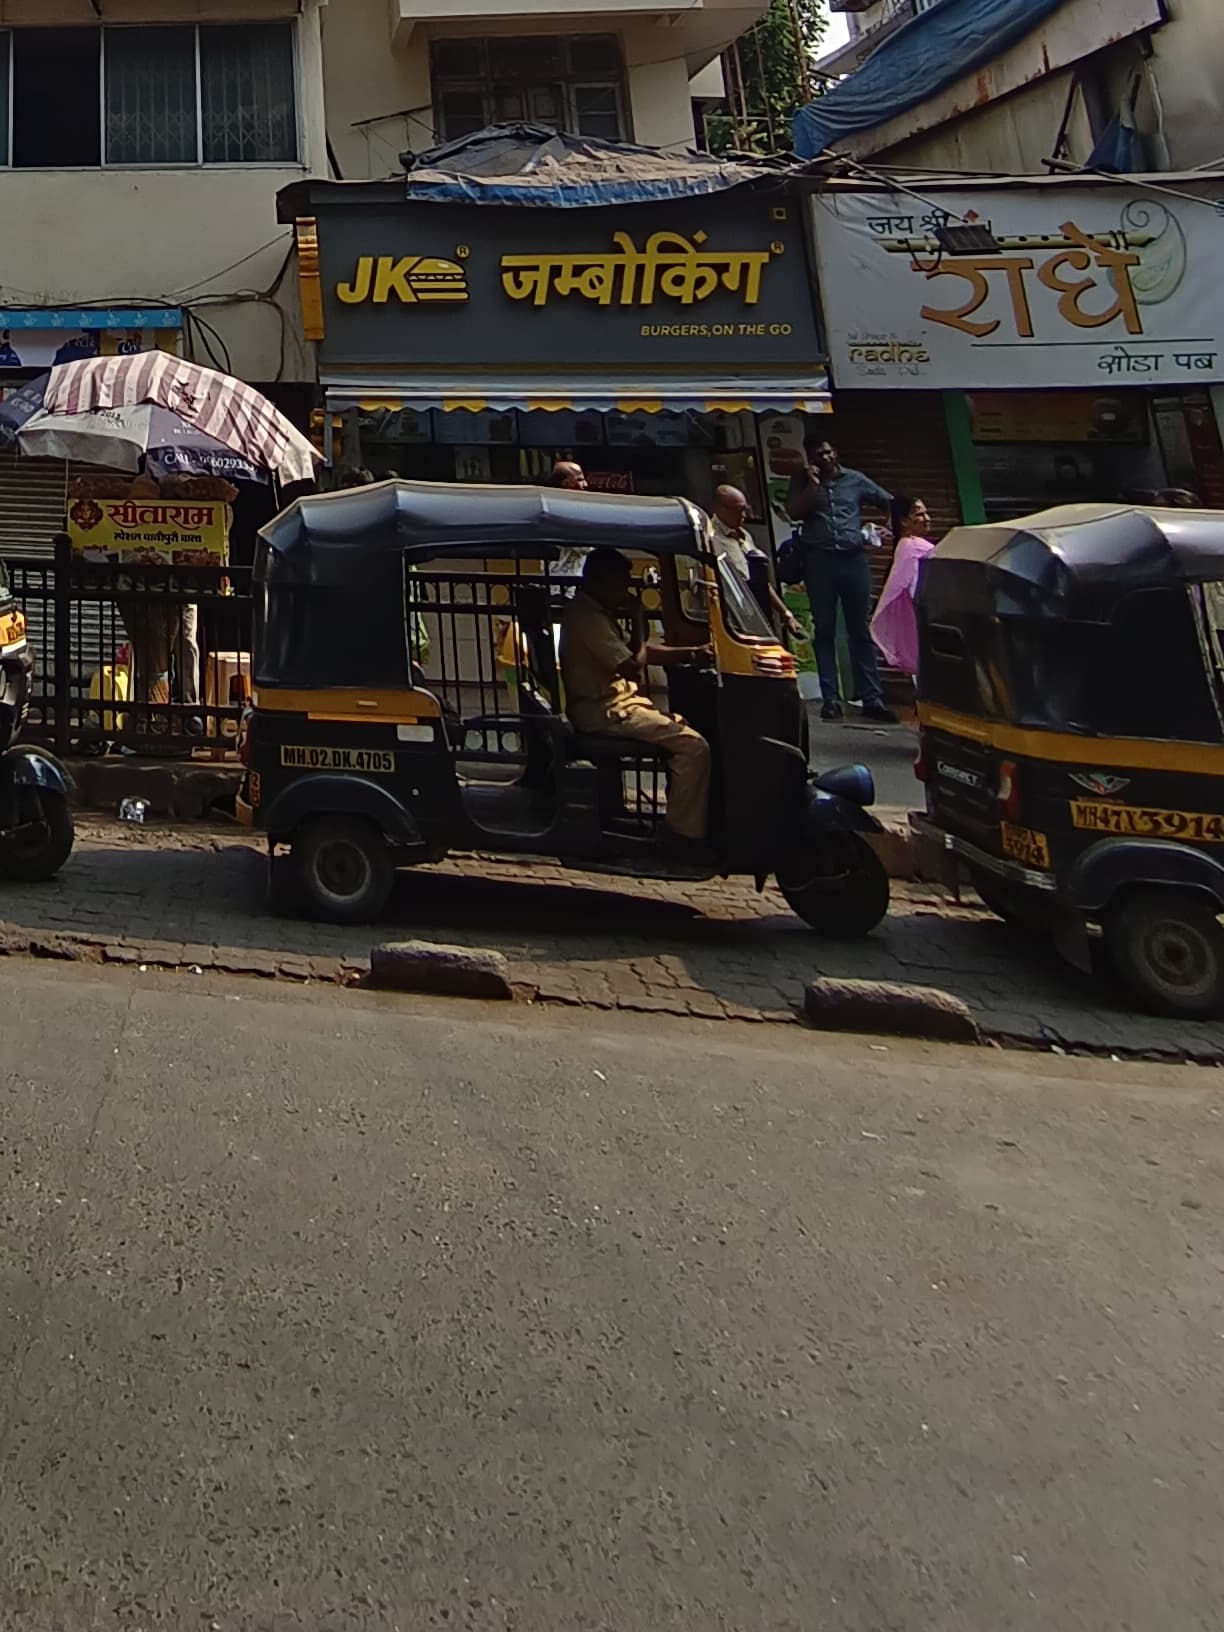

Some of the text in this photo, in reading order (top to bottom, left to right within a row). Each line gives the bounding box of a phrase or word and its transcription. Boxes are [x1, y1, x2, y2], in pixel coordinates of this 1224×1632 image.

[866, 215, 914, 235] जय
[337, 256, 422, 304] JK
[501, 229, 769, 305] जम्बोकिंग
[910, 221, 1144, 339] राधे
[739, 323, 766, 336] THE
[770, 323, 792, 336] GO
[848, 342, 931, 364] radhe
[1096, 345, 1218, 375] सोडा पब
[105, 500, 216, 531] सीताराम
[282, 747, 393, 770] MH.02.DK.4705
